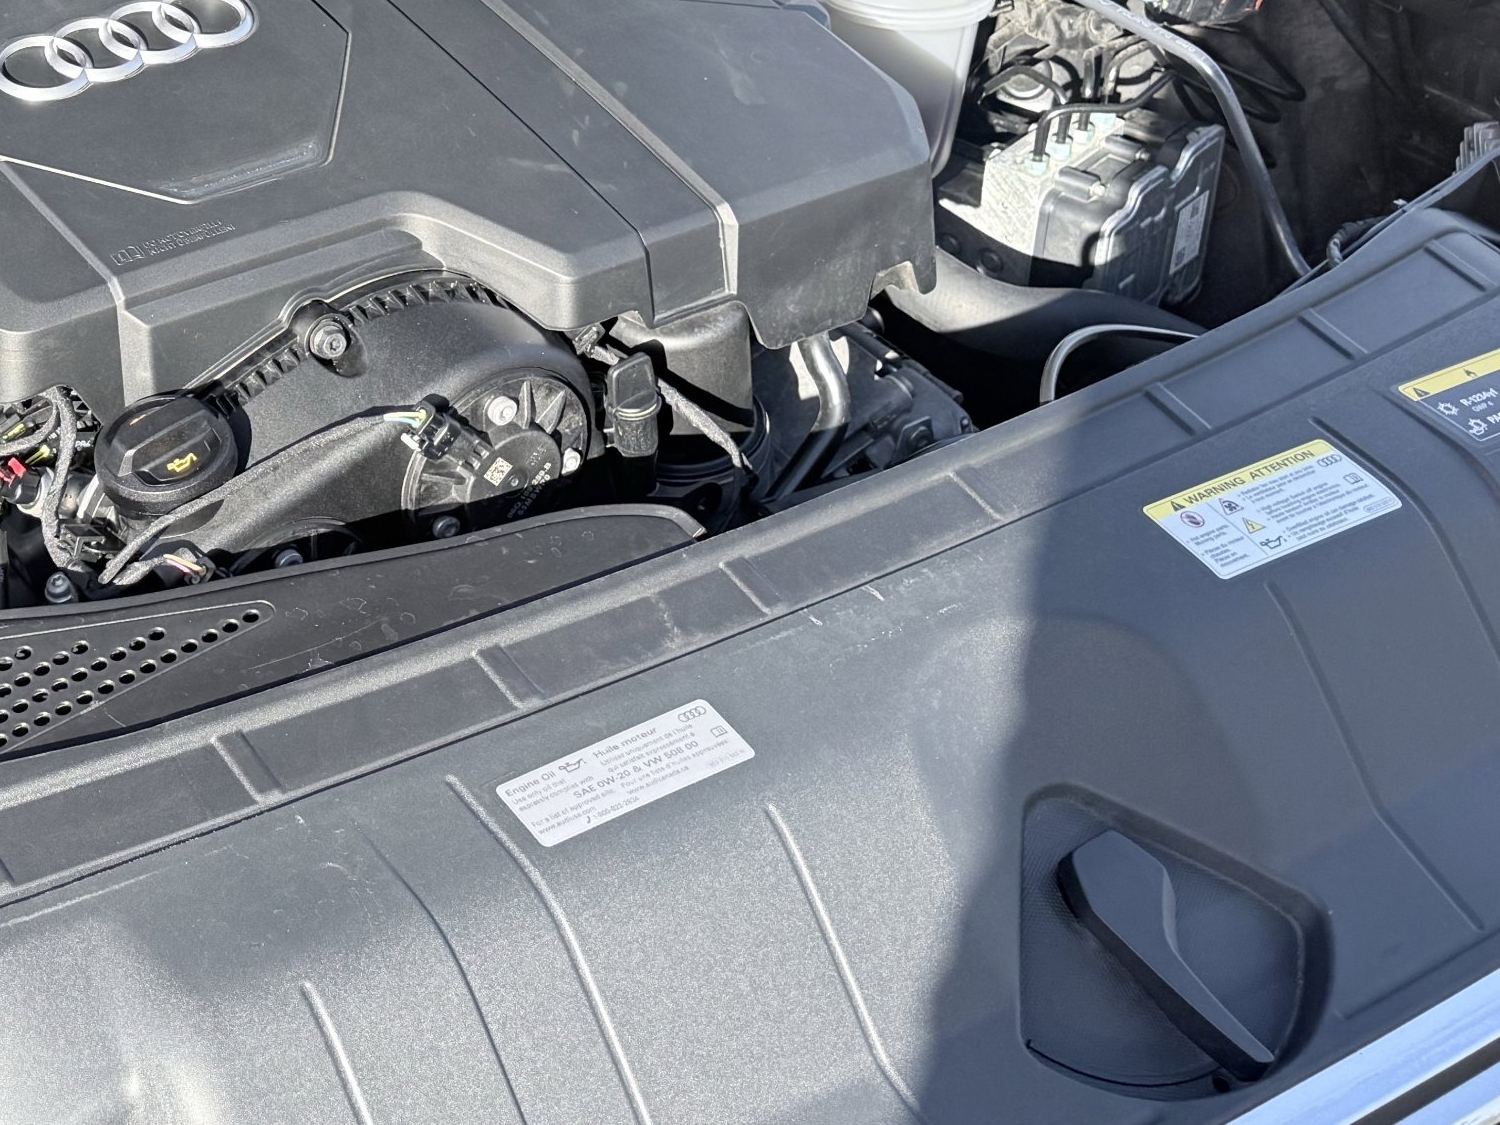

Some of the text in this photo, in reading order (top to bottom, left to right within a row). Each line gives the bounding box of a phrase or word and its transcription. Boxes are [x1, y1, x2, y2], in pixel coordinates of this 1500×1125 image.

[1183, 477, 1245, 504] WARNING
[1247, 450, 1314, 479] ATTENTION
[592, 727, 657, 758] Huile moteur
[504, 770, 556, 797] Engine Oil
[572, 740, 699, 798] SAE 0W-20 & VW 508 00
